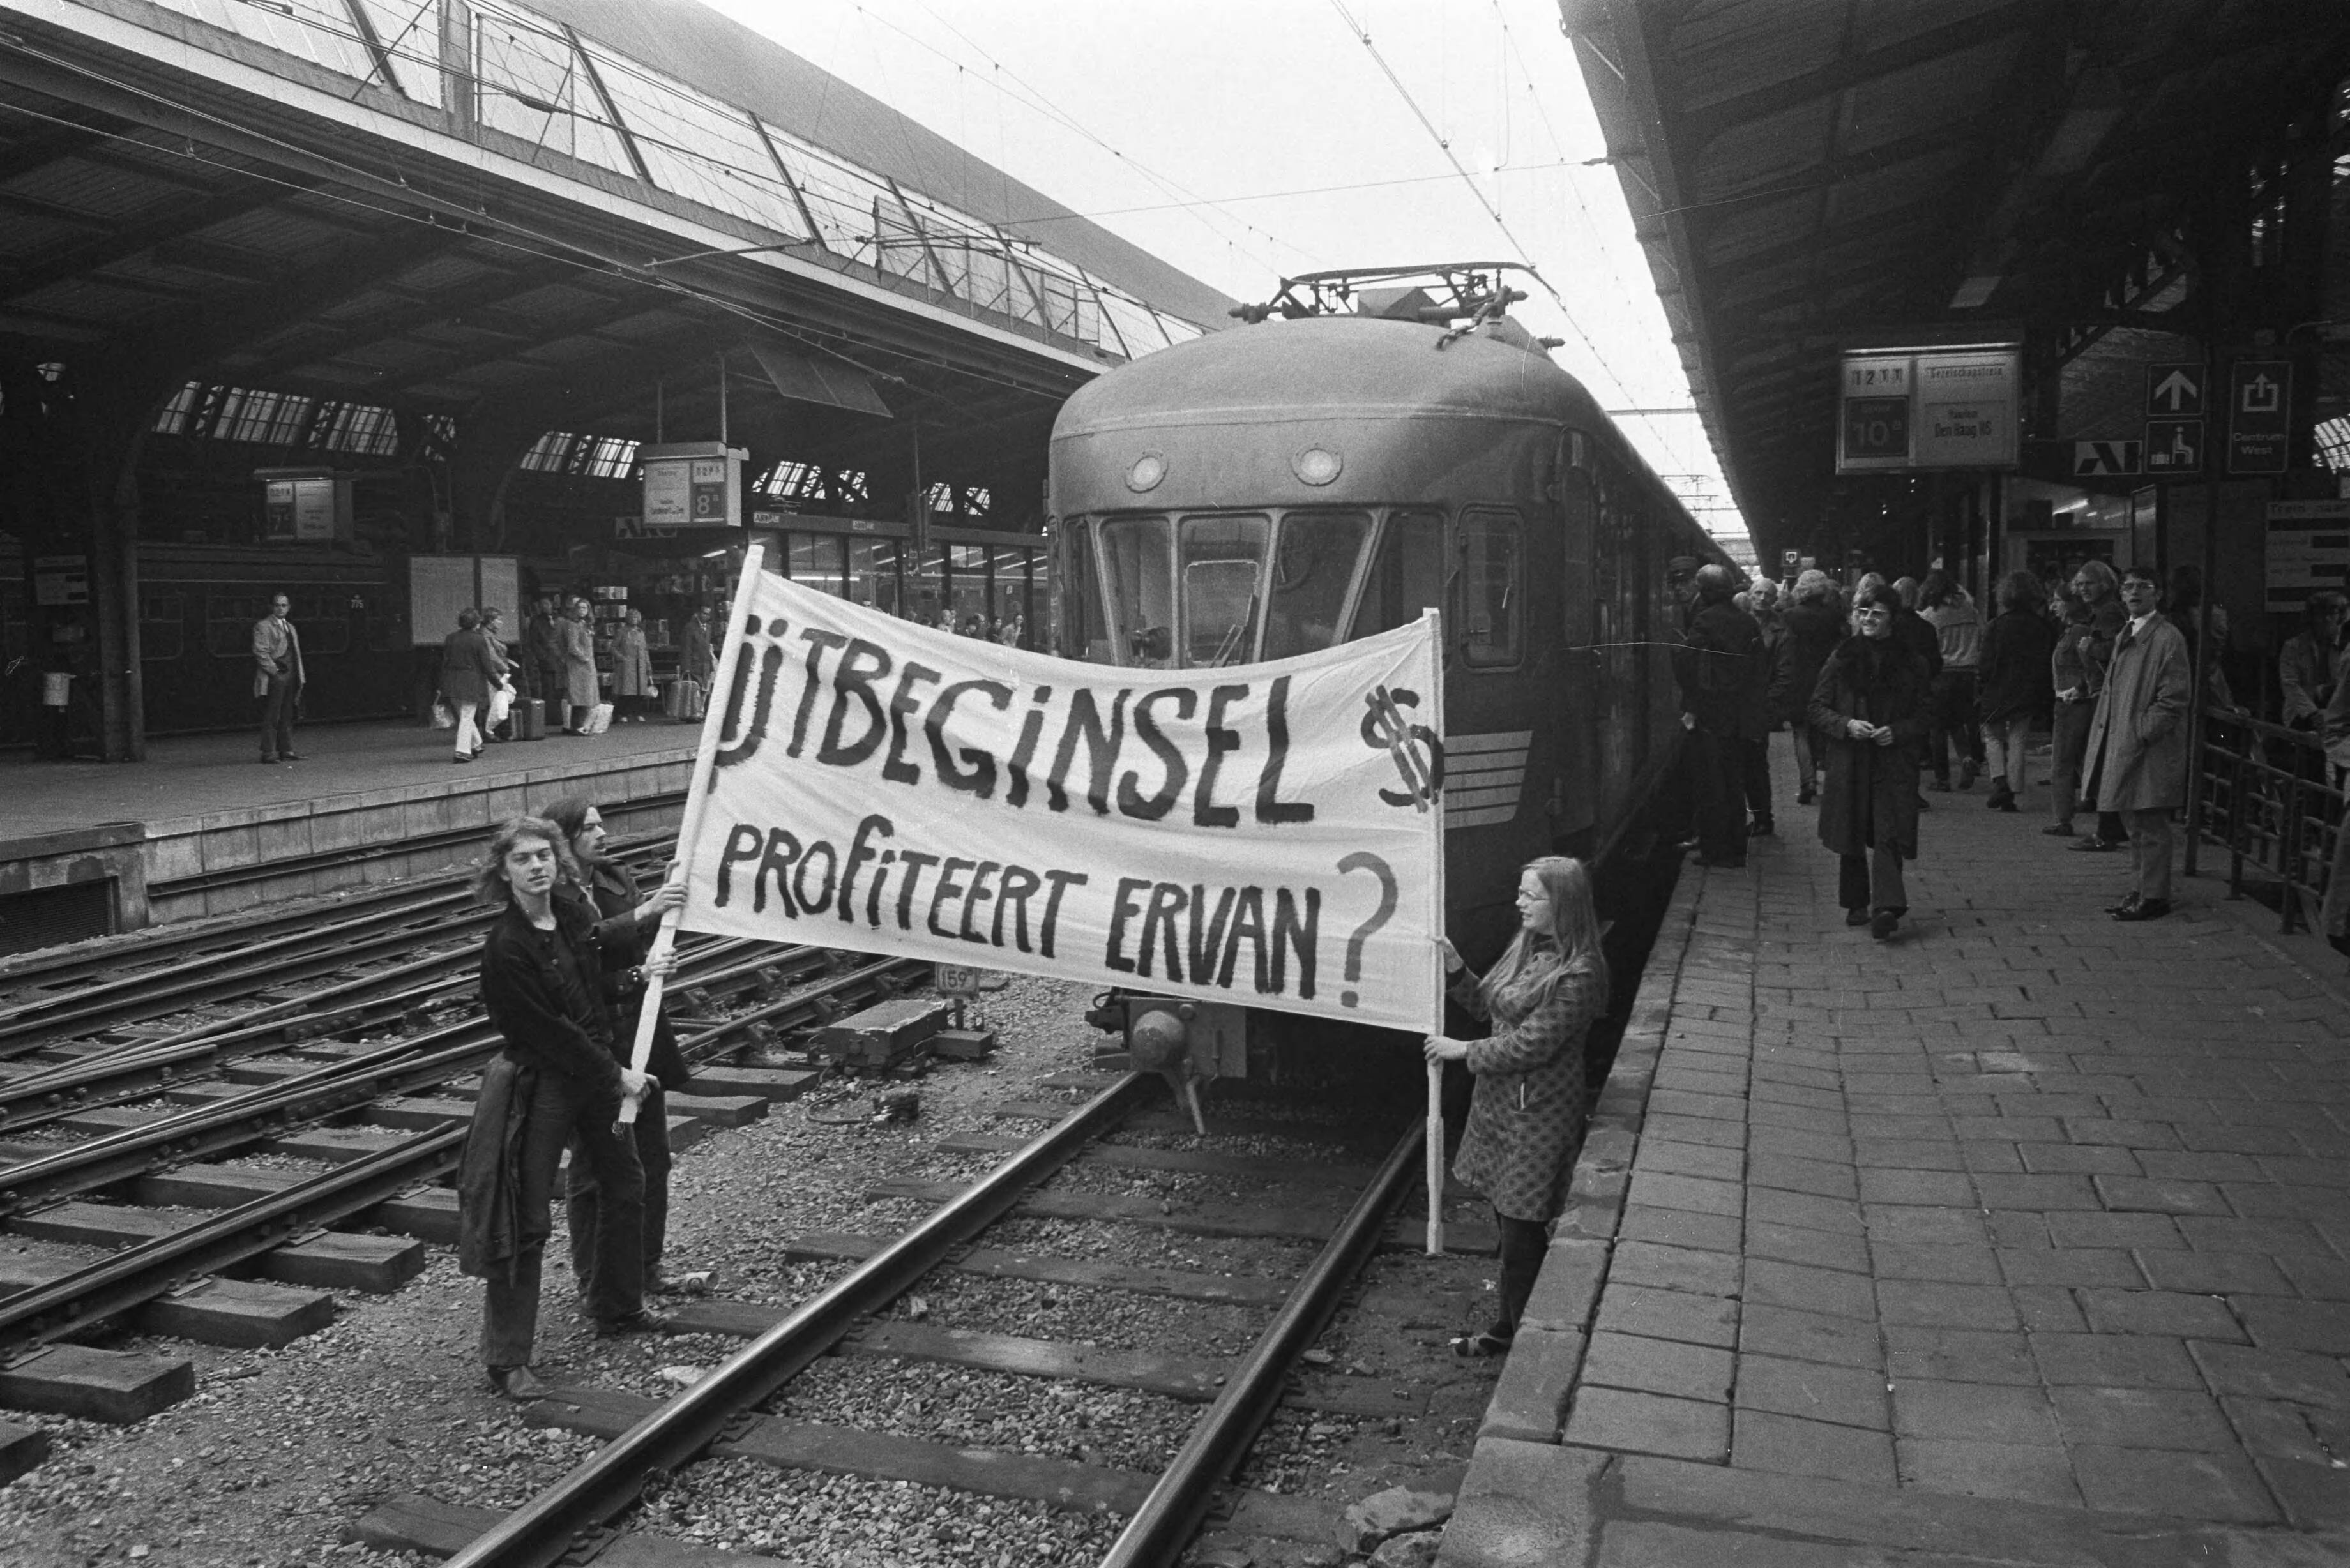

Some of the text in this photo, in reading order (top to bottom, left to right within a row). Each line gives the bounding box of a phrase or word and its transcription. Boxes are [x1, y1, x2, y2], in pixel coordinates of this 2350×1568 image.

[2233, 432, 2284, 442] Centrum
[2240, 446, 2273, 455] West
[942, 970, 967, 988] 159
